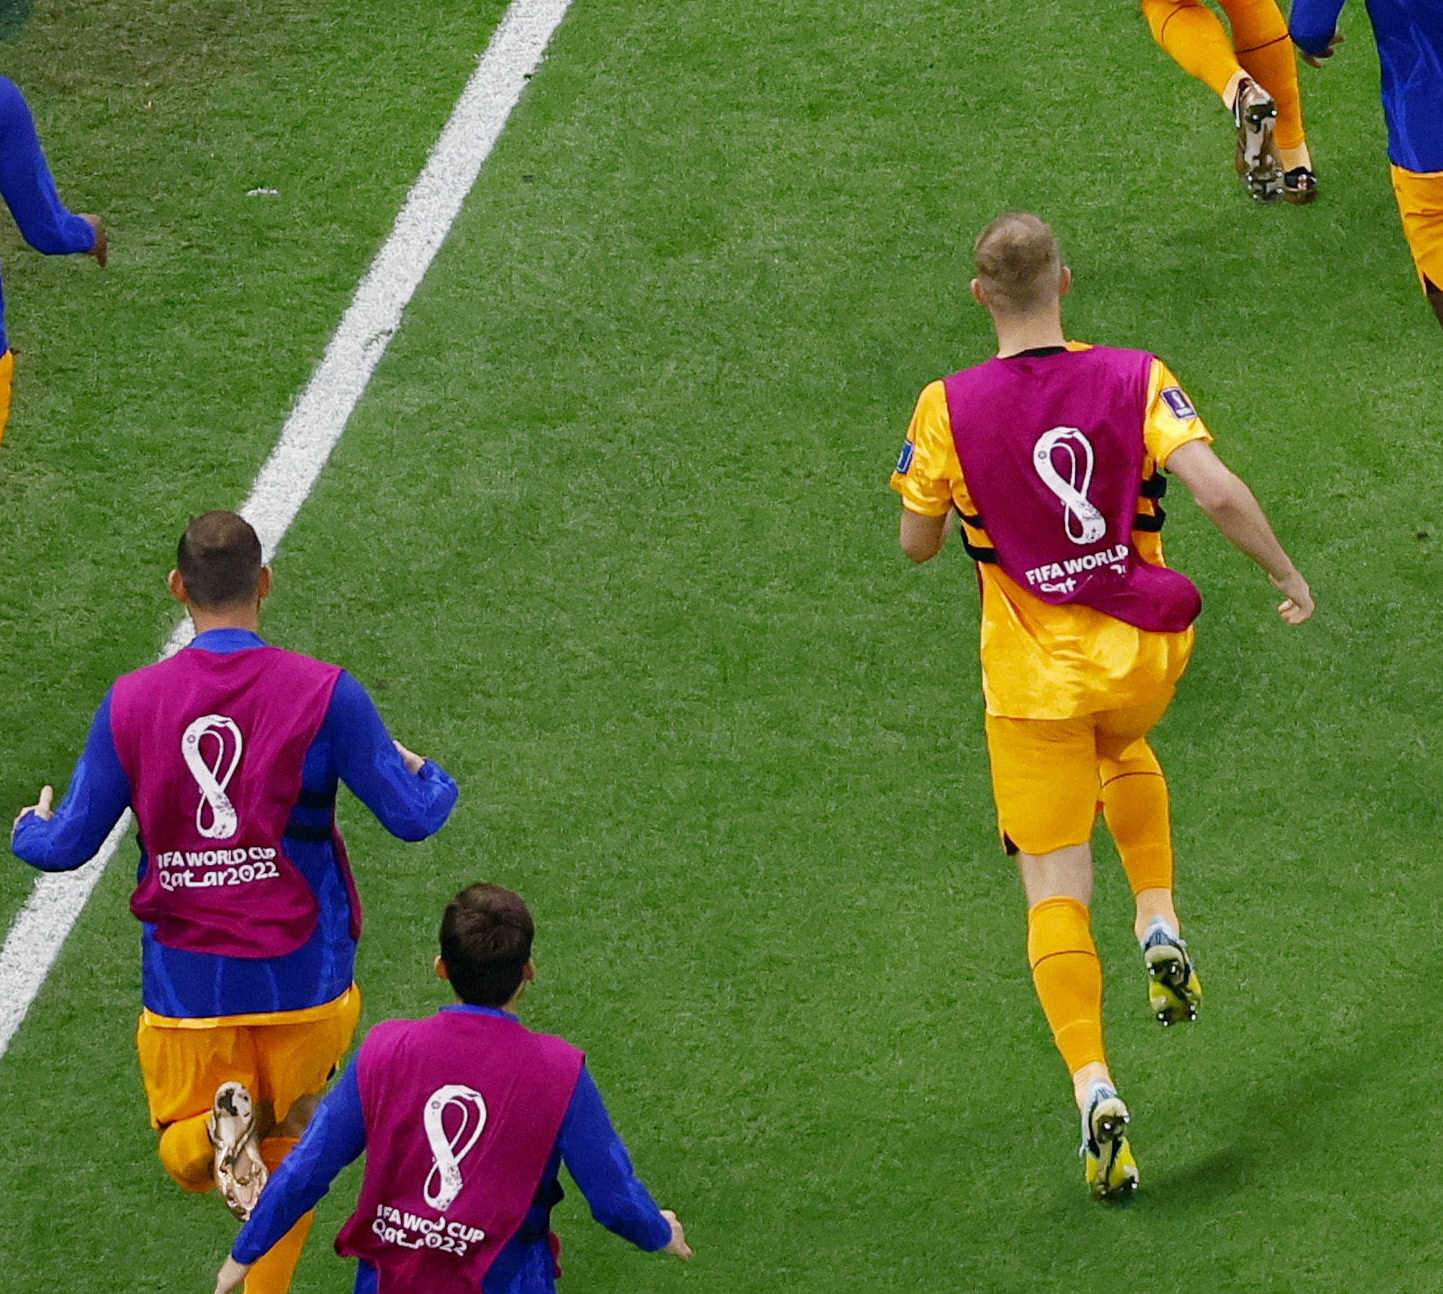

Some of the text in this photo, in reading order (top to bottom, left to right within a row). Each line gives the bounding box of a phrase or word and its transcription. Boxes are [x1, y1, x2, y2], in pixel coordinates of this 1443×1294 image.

[1026, 562, 1065, 587] FIFA
[1062, 544, 1129, 577] WORLD
[185, 848, 247, 868] WORLD
[158, 861, 280, 892] Qatar2022
[446, 1216, 485, 1243] CUP
